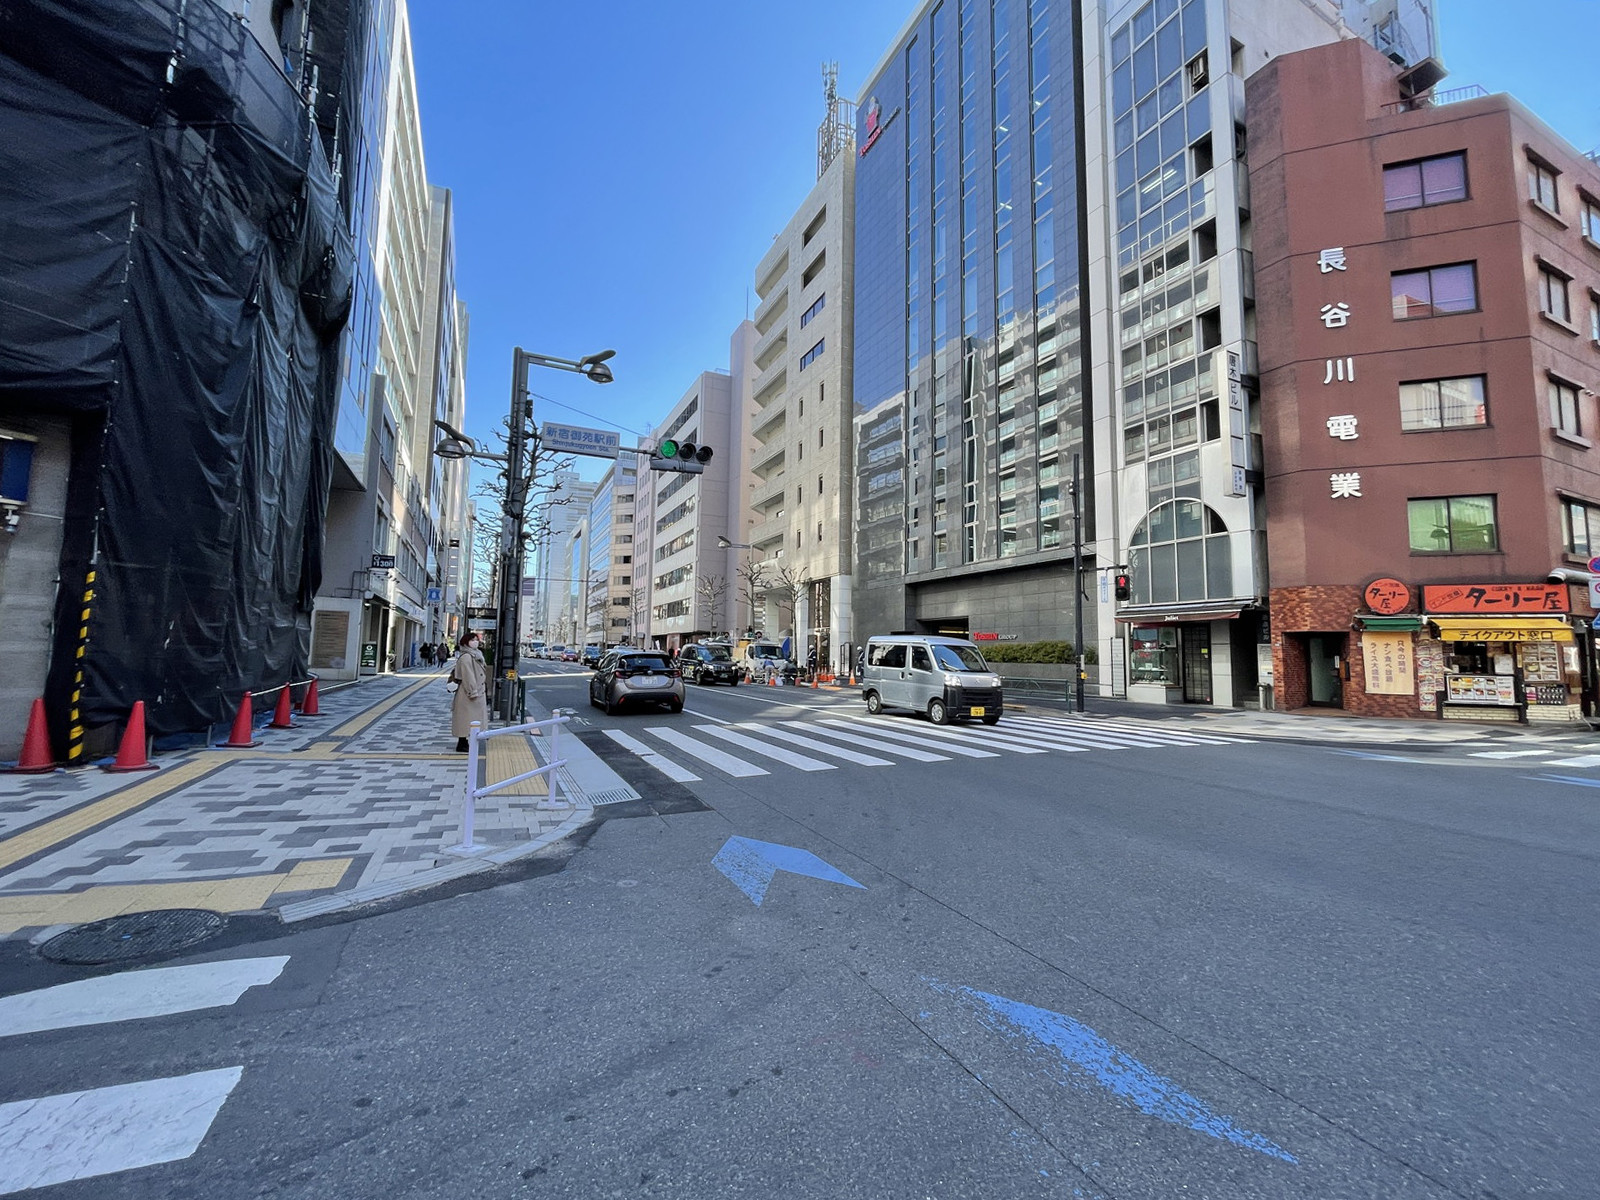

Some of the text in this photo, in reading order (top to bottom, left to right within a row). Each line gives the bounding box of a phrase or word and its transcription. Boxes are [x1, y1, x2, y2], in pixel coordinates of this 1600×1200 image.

[1317, 247, 1362, 499] 長谷川電業
[546, 426, 617, 446] 新宿御苑駅前
[1369, 587, 1406, 599] ターリー
[1465, 587, 1562, 609] ターリー屋
[1380, 598, 1391, 609] 屋
[1460, 630, 1553, 640] テイクアウト窓口
